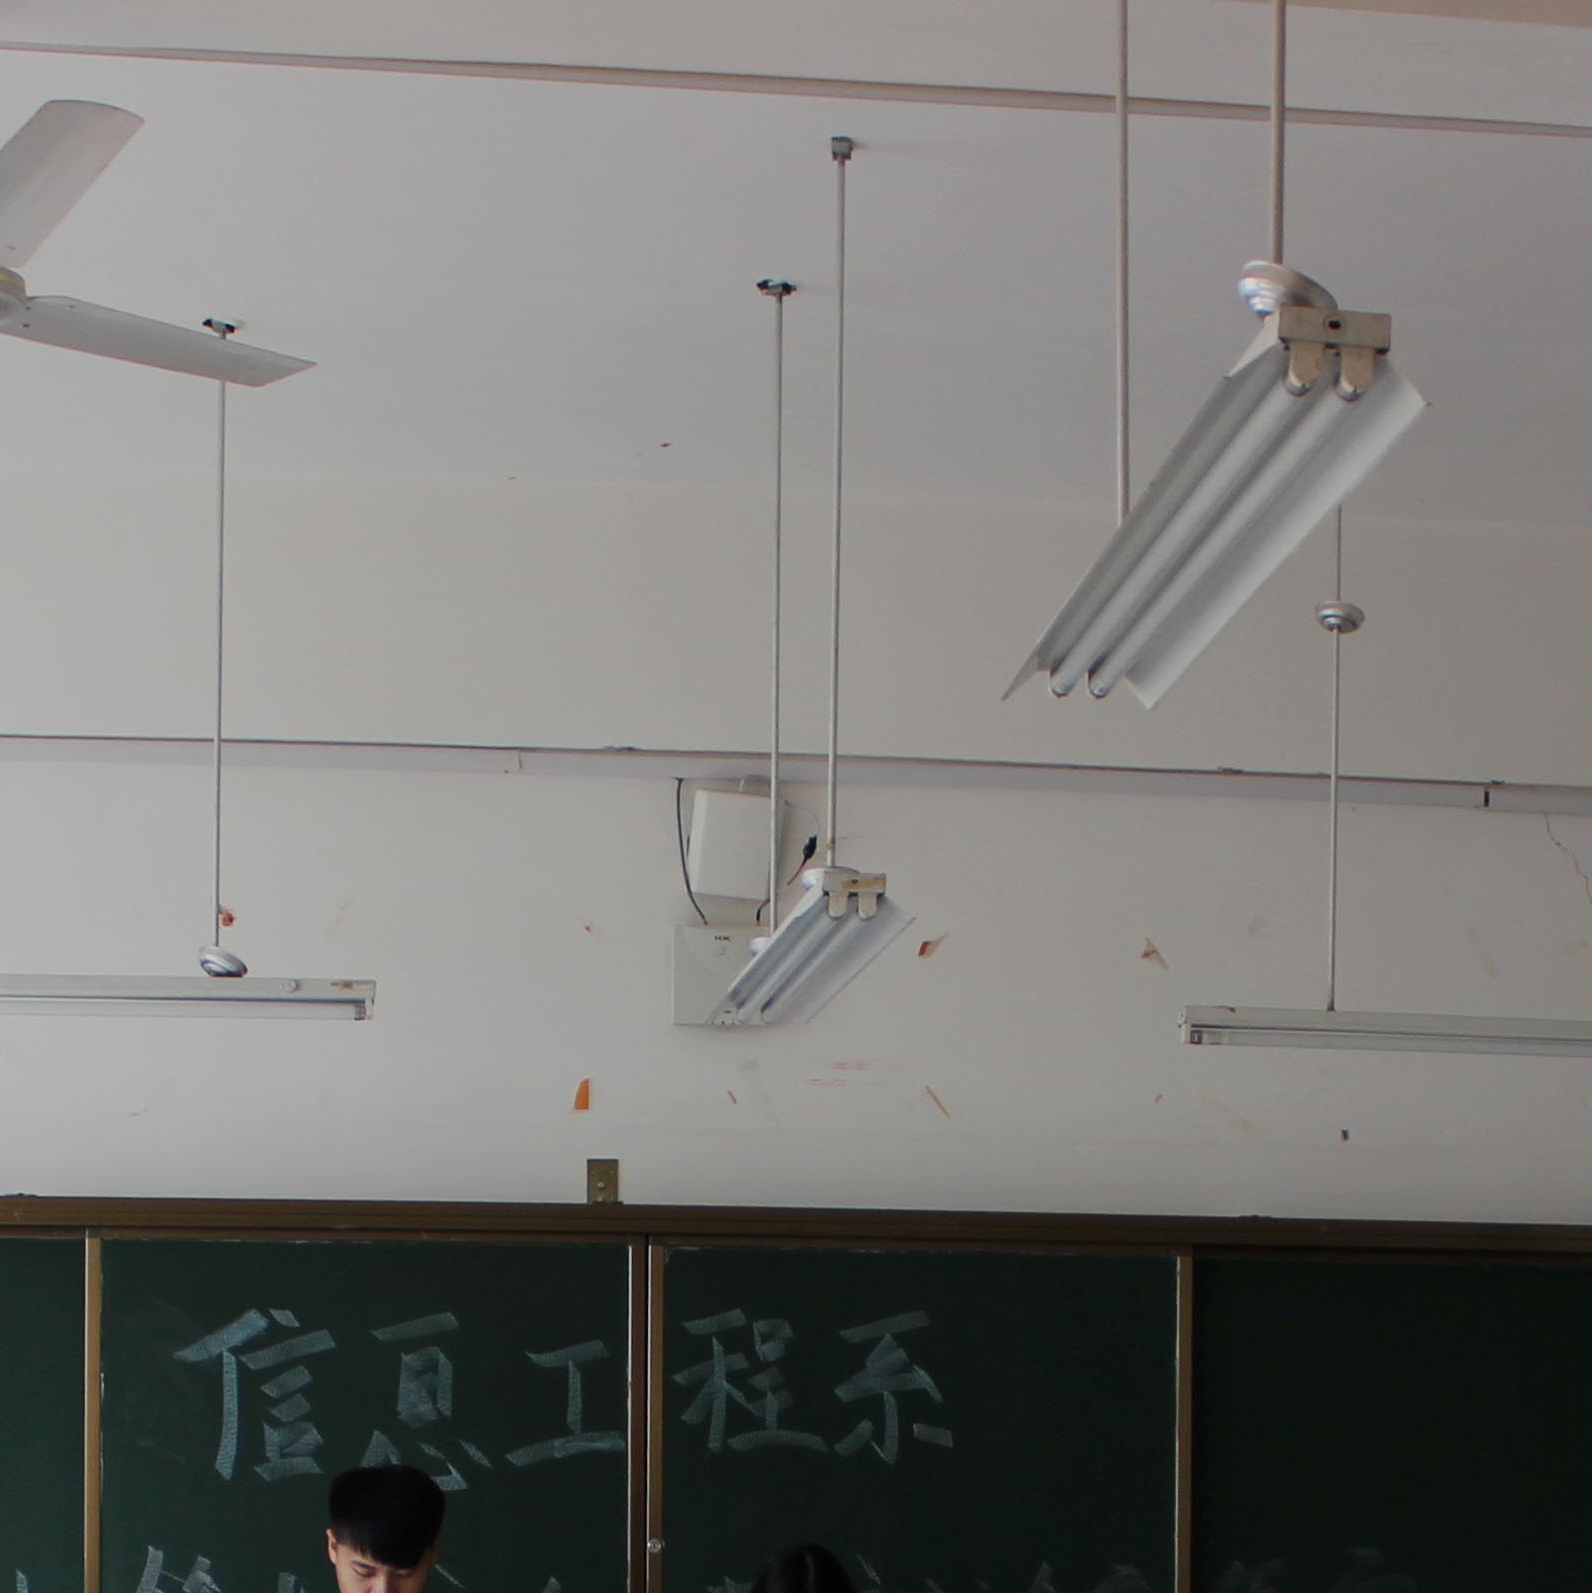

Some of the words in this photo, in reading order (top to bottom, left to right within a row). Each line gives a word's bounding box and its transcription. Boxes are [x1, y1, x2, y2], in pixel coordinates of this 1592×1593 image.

[172, 1306, 955, 1492] 信息工程系
